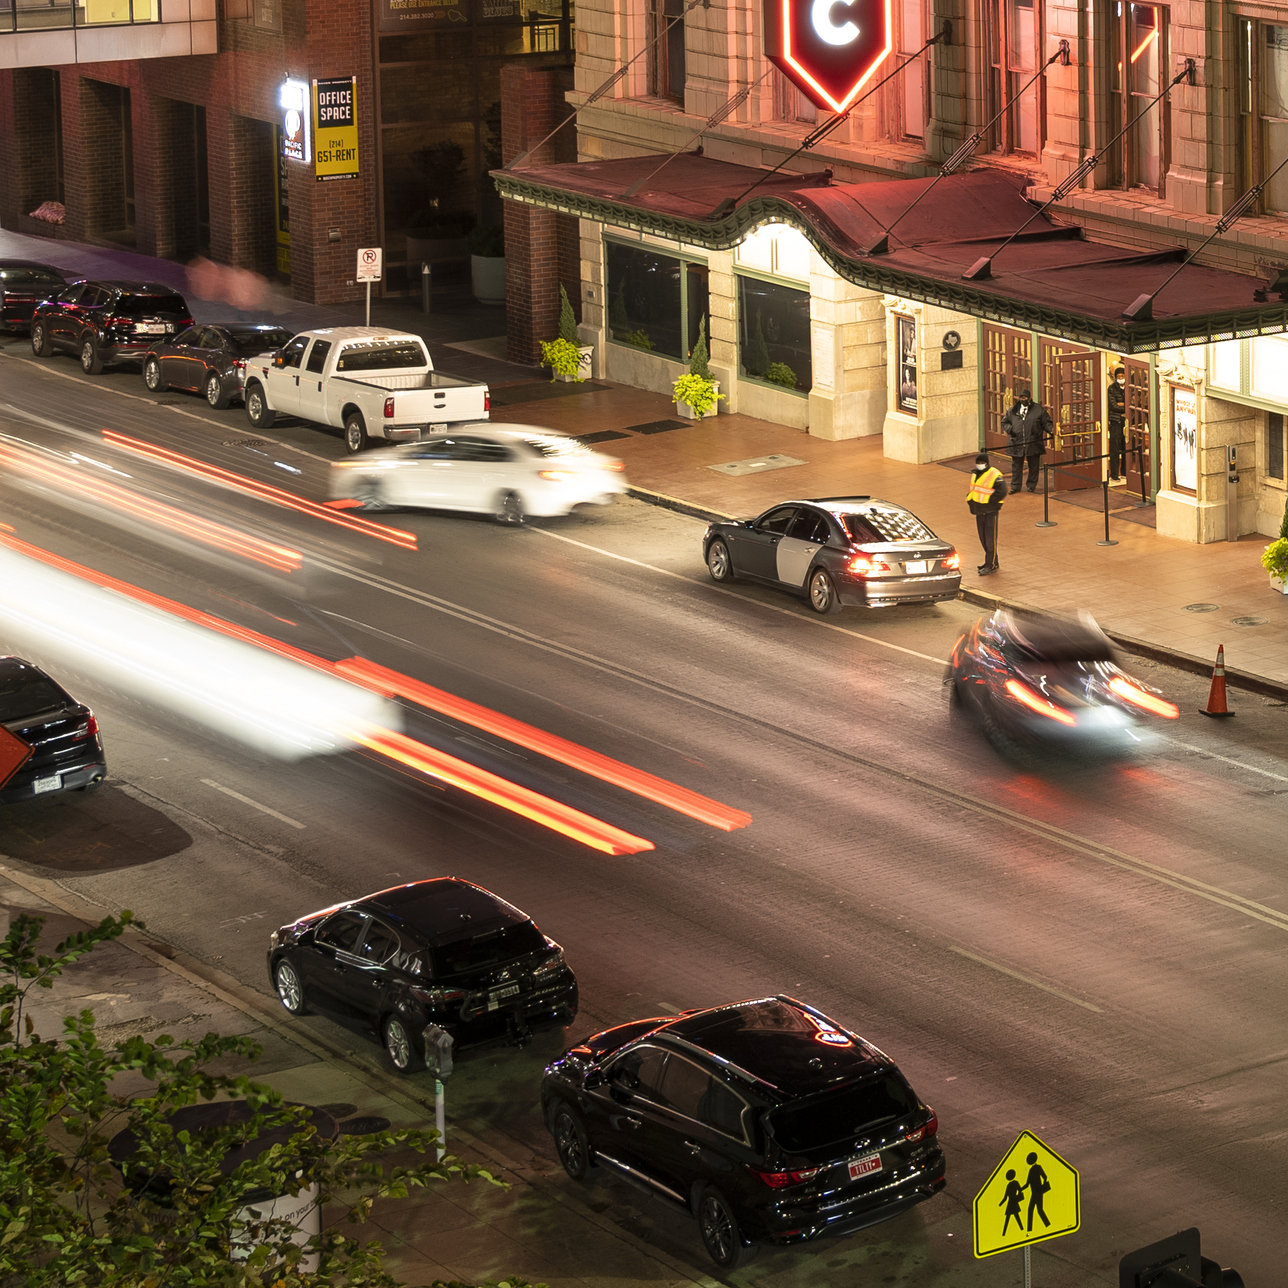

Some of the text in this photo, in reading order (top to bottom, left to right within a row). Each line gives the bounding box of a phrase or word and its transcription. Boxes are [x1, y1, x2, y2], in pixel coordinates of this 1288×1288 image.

[319, 91, 352, 105] OFFICE
[320, 106, 351, 121] SPACE
[317, 148, 356, 163] 651-RENT
[284, 1211, 295, 1221] on
